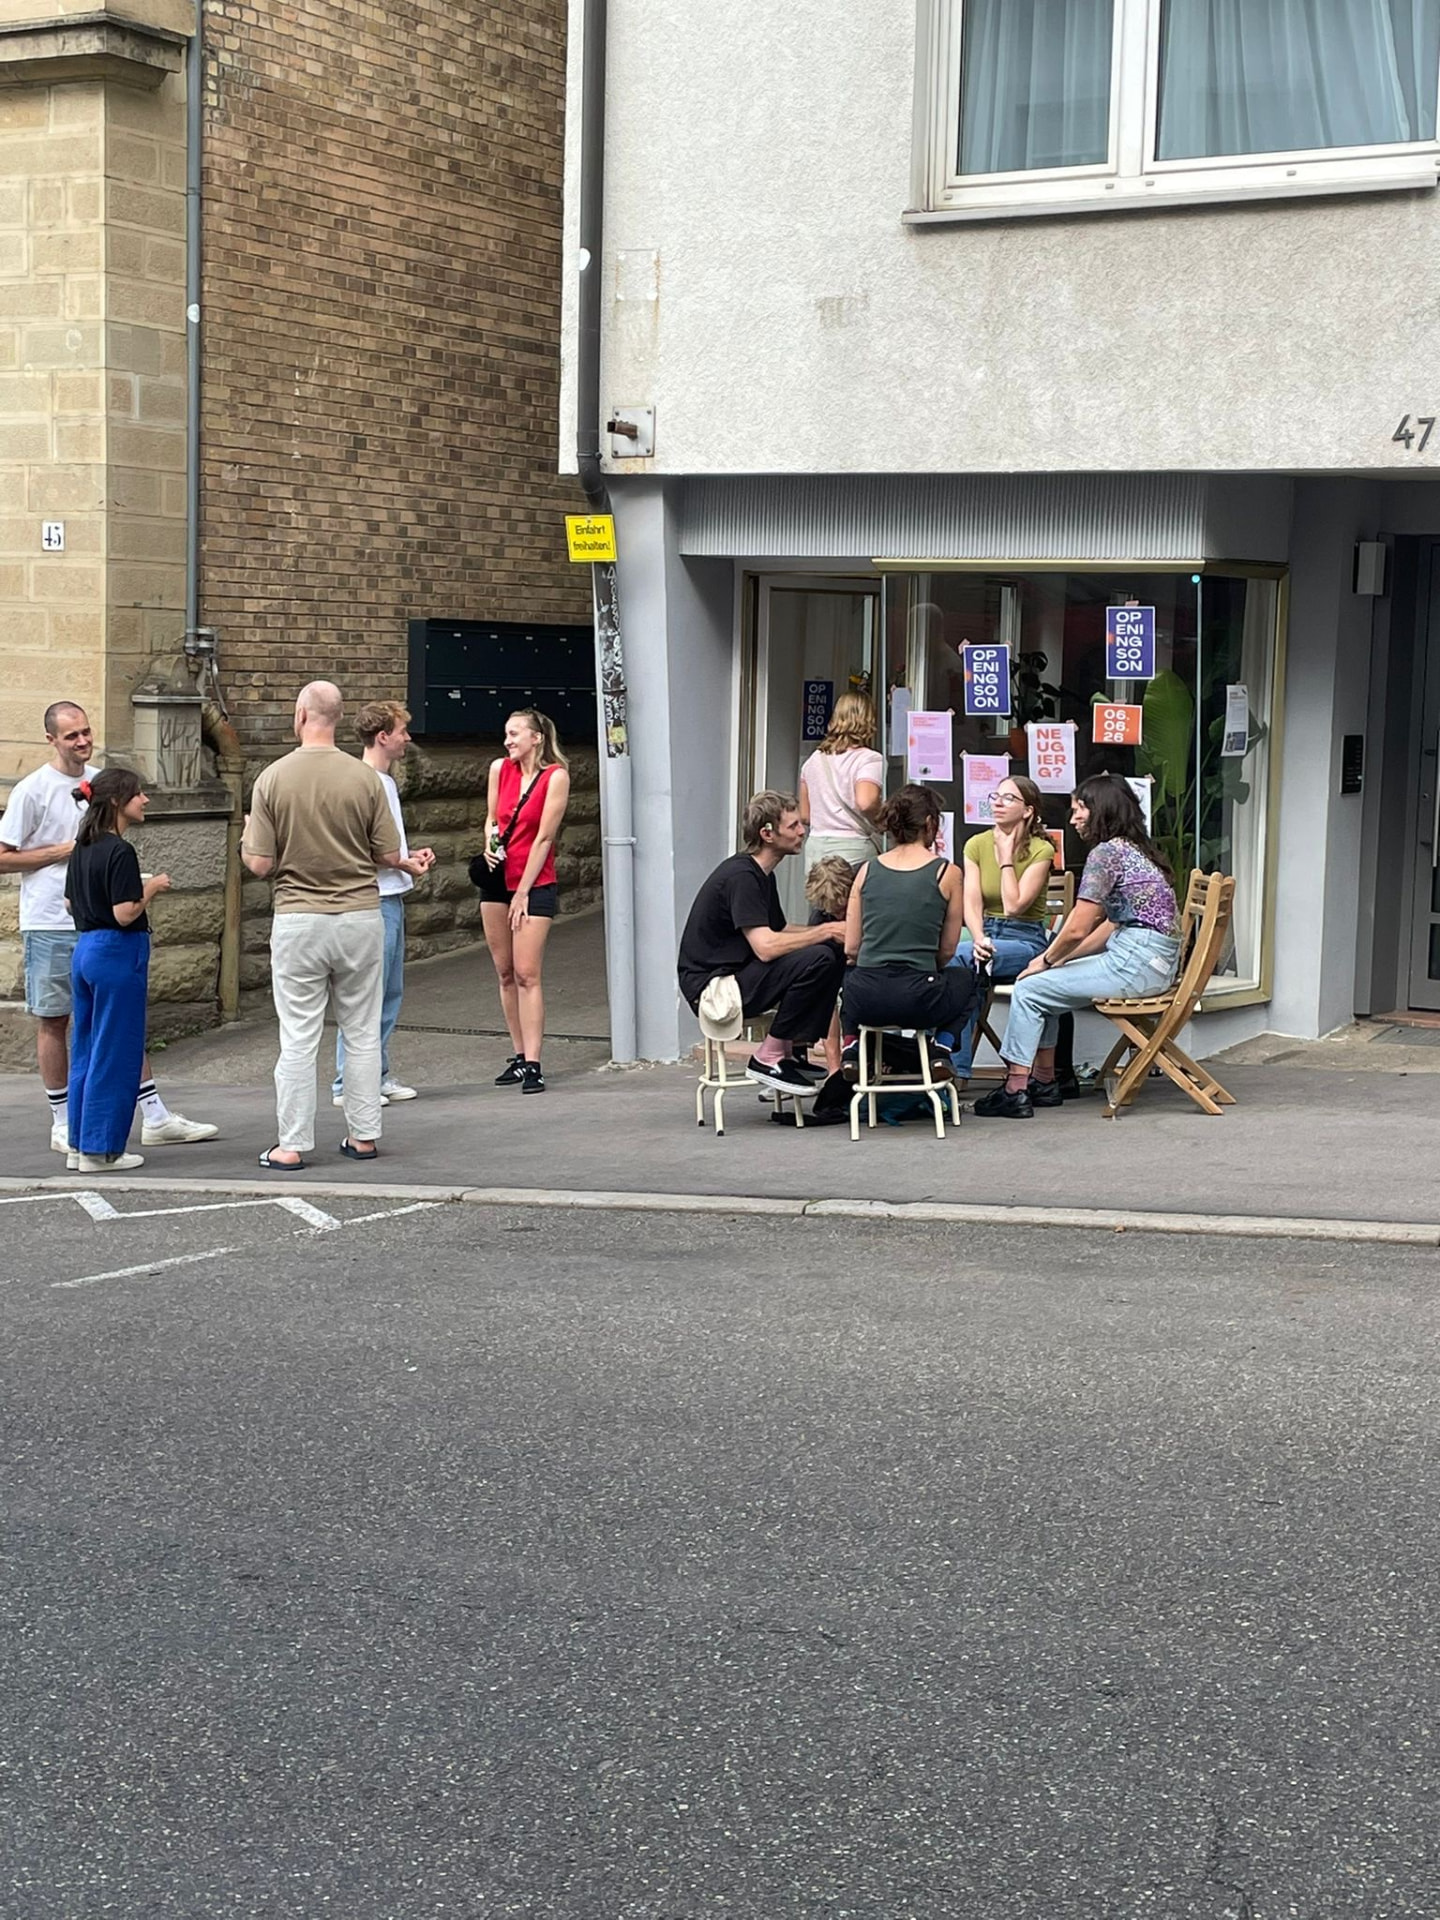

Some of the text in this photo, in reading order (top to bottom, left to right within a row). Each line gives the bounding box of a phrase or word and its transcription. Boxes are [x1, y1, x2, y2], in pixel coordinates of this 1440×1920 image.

[1391, 413, 1436, 452] 47
[575, 525, 606, 535] Einfahrt
[44, 525, 62, 547] 45
[1116, 611, 1142, 623] OP
[1116, 624, 1144, 635] ENI
[1116, 636, 1143, 648] NG
[972, 650, 997, 661] OP
[1116, 648, 1141, 660] SO
[973, 661, 999, 672] ENI
[1116, 660, 1143, 672] ON
[973, 673, 998, 684] NG
[808, 683, 826, 694] OP
[973, 685, 997, 696] SO
[808, 694, 827, 704] ENI
[974, 697, 999, 708] ON
[807, 705, 825, 714] NG
[1104, 709, 1130, 720] 06.
[807, 715, 824, 725] SO
[806, 726, 825, 736] ON
[1036, 728, 1061, 739] NE
[1103, 731, 1124, 743] 26
[1036, 741, 1064, 752] UG
[1037, 754, 1067, 765] IER
[1038, 767, 1063, 778] G?
